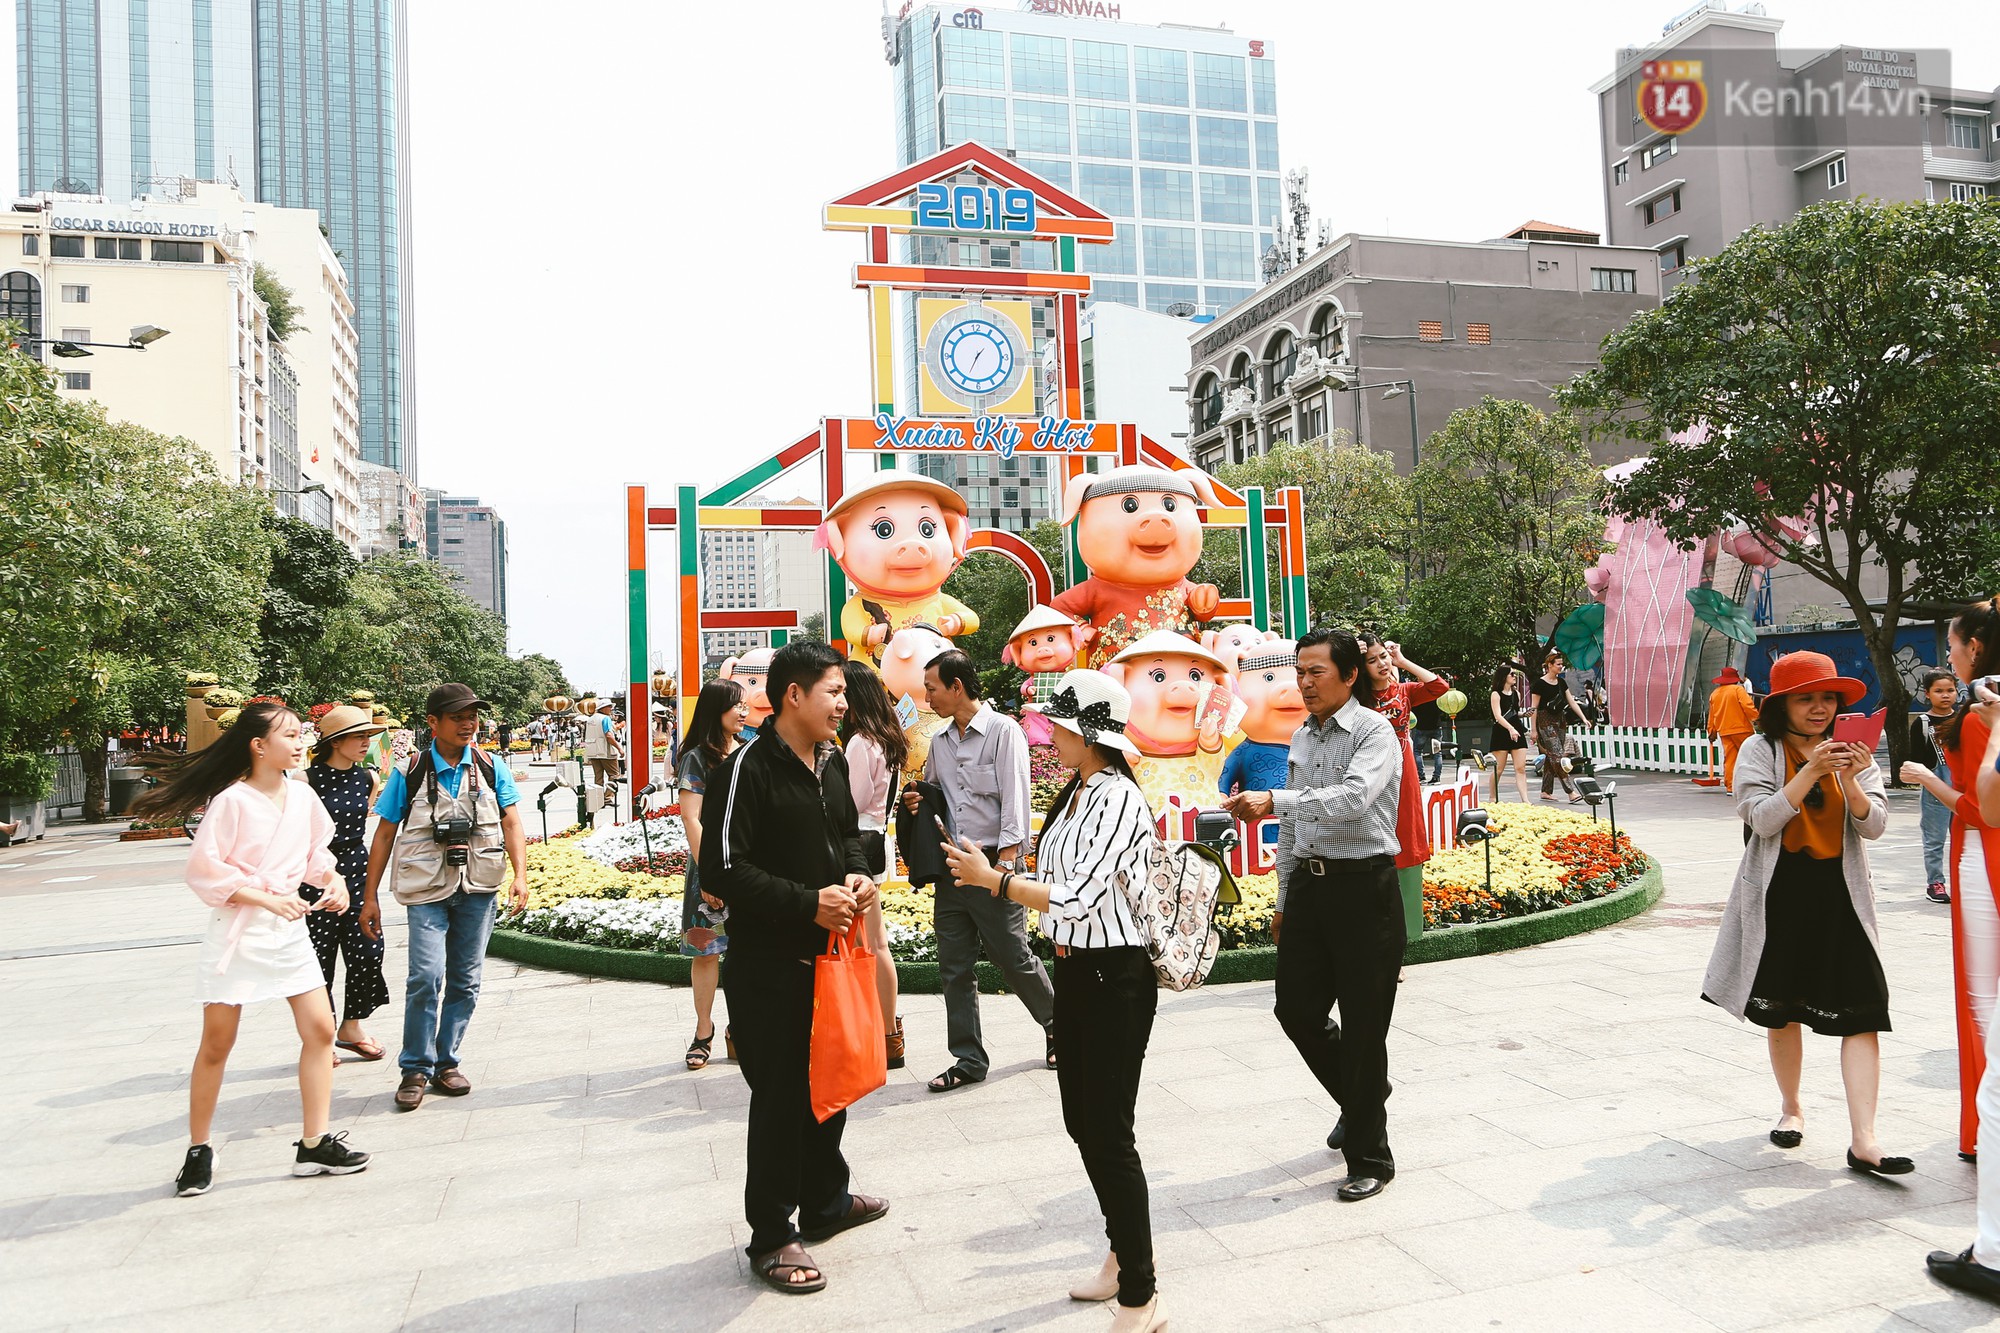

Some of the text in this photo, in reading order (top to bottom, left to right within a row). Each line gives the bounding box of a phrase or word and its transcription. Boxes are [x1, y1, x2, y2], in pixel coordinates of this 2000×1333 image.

[1032, 0, 1120, 19] SUNWAH
[953, 10, 983, 29] citi
[1861, 48, 1899, 63] KIM DO
[1847, 60, 1916, 78] ROYAL HOTEL
[1863, 76, 1900, 90] SAIGON
[917, 182, 1037, 233] 2019
[53, 217, 218, 236] OSCAR SAIGON HOTEL
[1291, 262, 1333, 301] HOTEL
[971, 324, 981, 332] 12
[875, 414, 1097, 459] Xuân Kỷ Hợi
